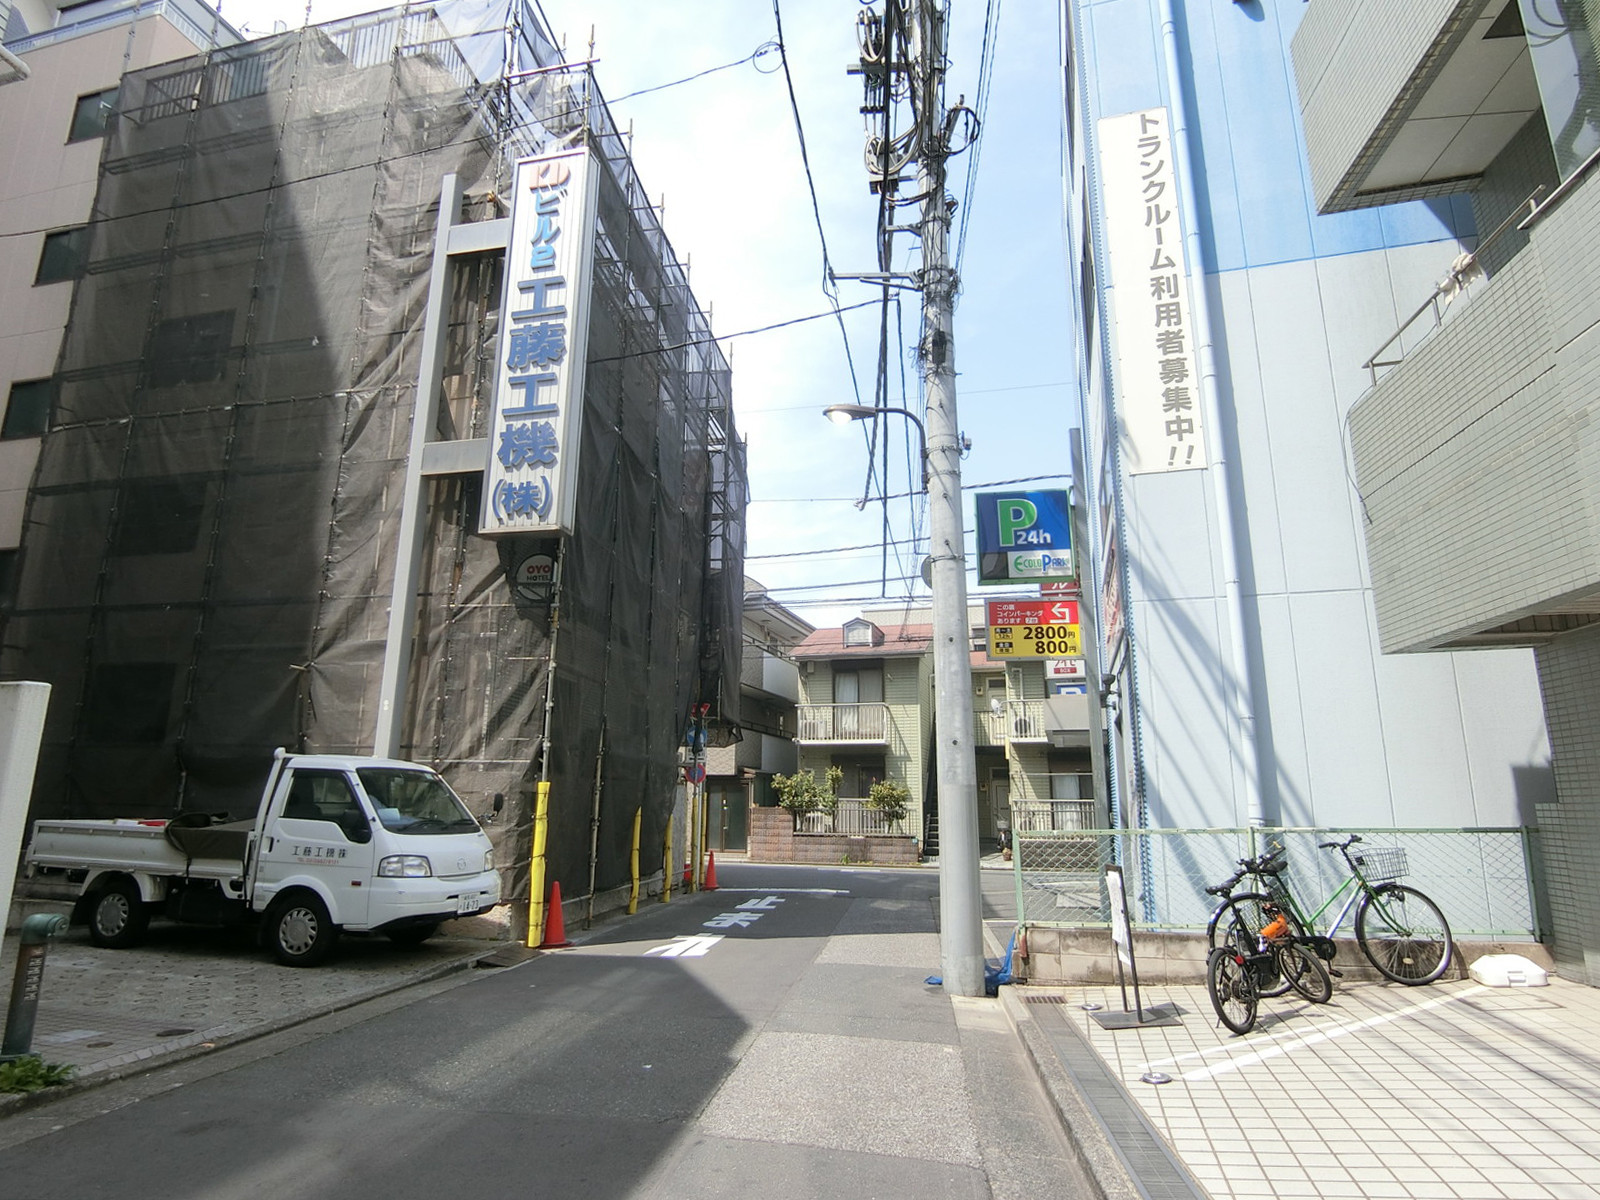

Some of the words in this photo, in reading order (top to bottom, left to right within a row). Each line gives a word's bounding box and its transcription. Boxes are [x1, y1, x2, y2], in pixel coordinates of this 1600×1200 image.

[1137, 114, 1194, 466] トランクルーム利用者募集中!!
[492, 276, 567, 520] 工藤工機(株)
[997, 499, 1037, 546] P
[1016, 529, 1051, 545] 24h
[527, 565, 551, 574] OYO
[997, 610, 1043, 618] コインパーキング
[643, 895, 786, 957] 止まれ
